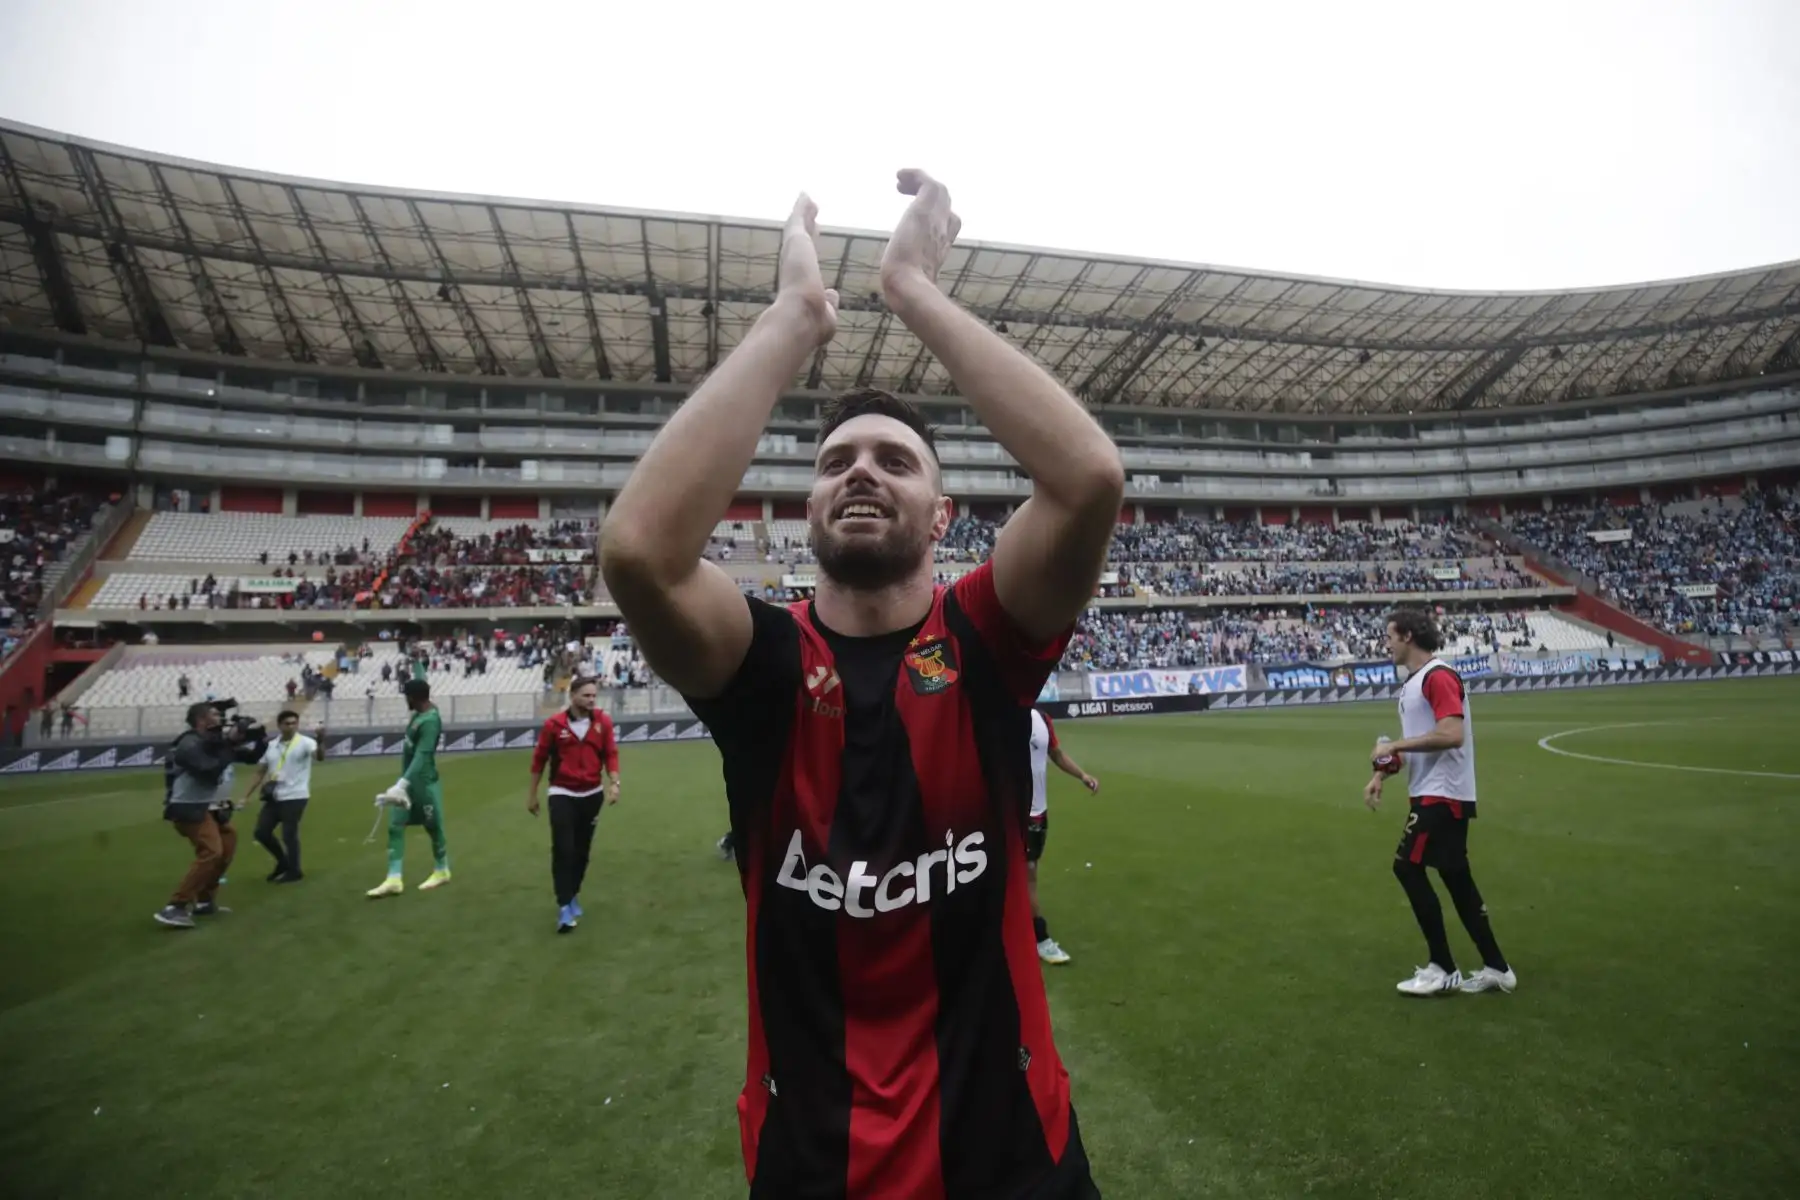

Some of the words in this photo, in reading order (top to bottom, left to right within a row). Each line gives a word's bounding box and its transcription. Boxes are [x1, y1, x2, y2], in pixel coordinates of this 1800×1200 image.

[1267, 667, 1330, 690] CONO
[1112, 701, 1154, 713] betsson
[776, 828, 988, 918] betcris
